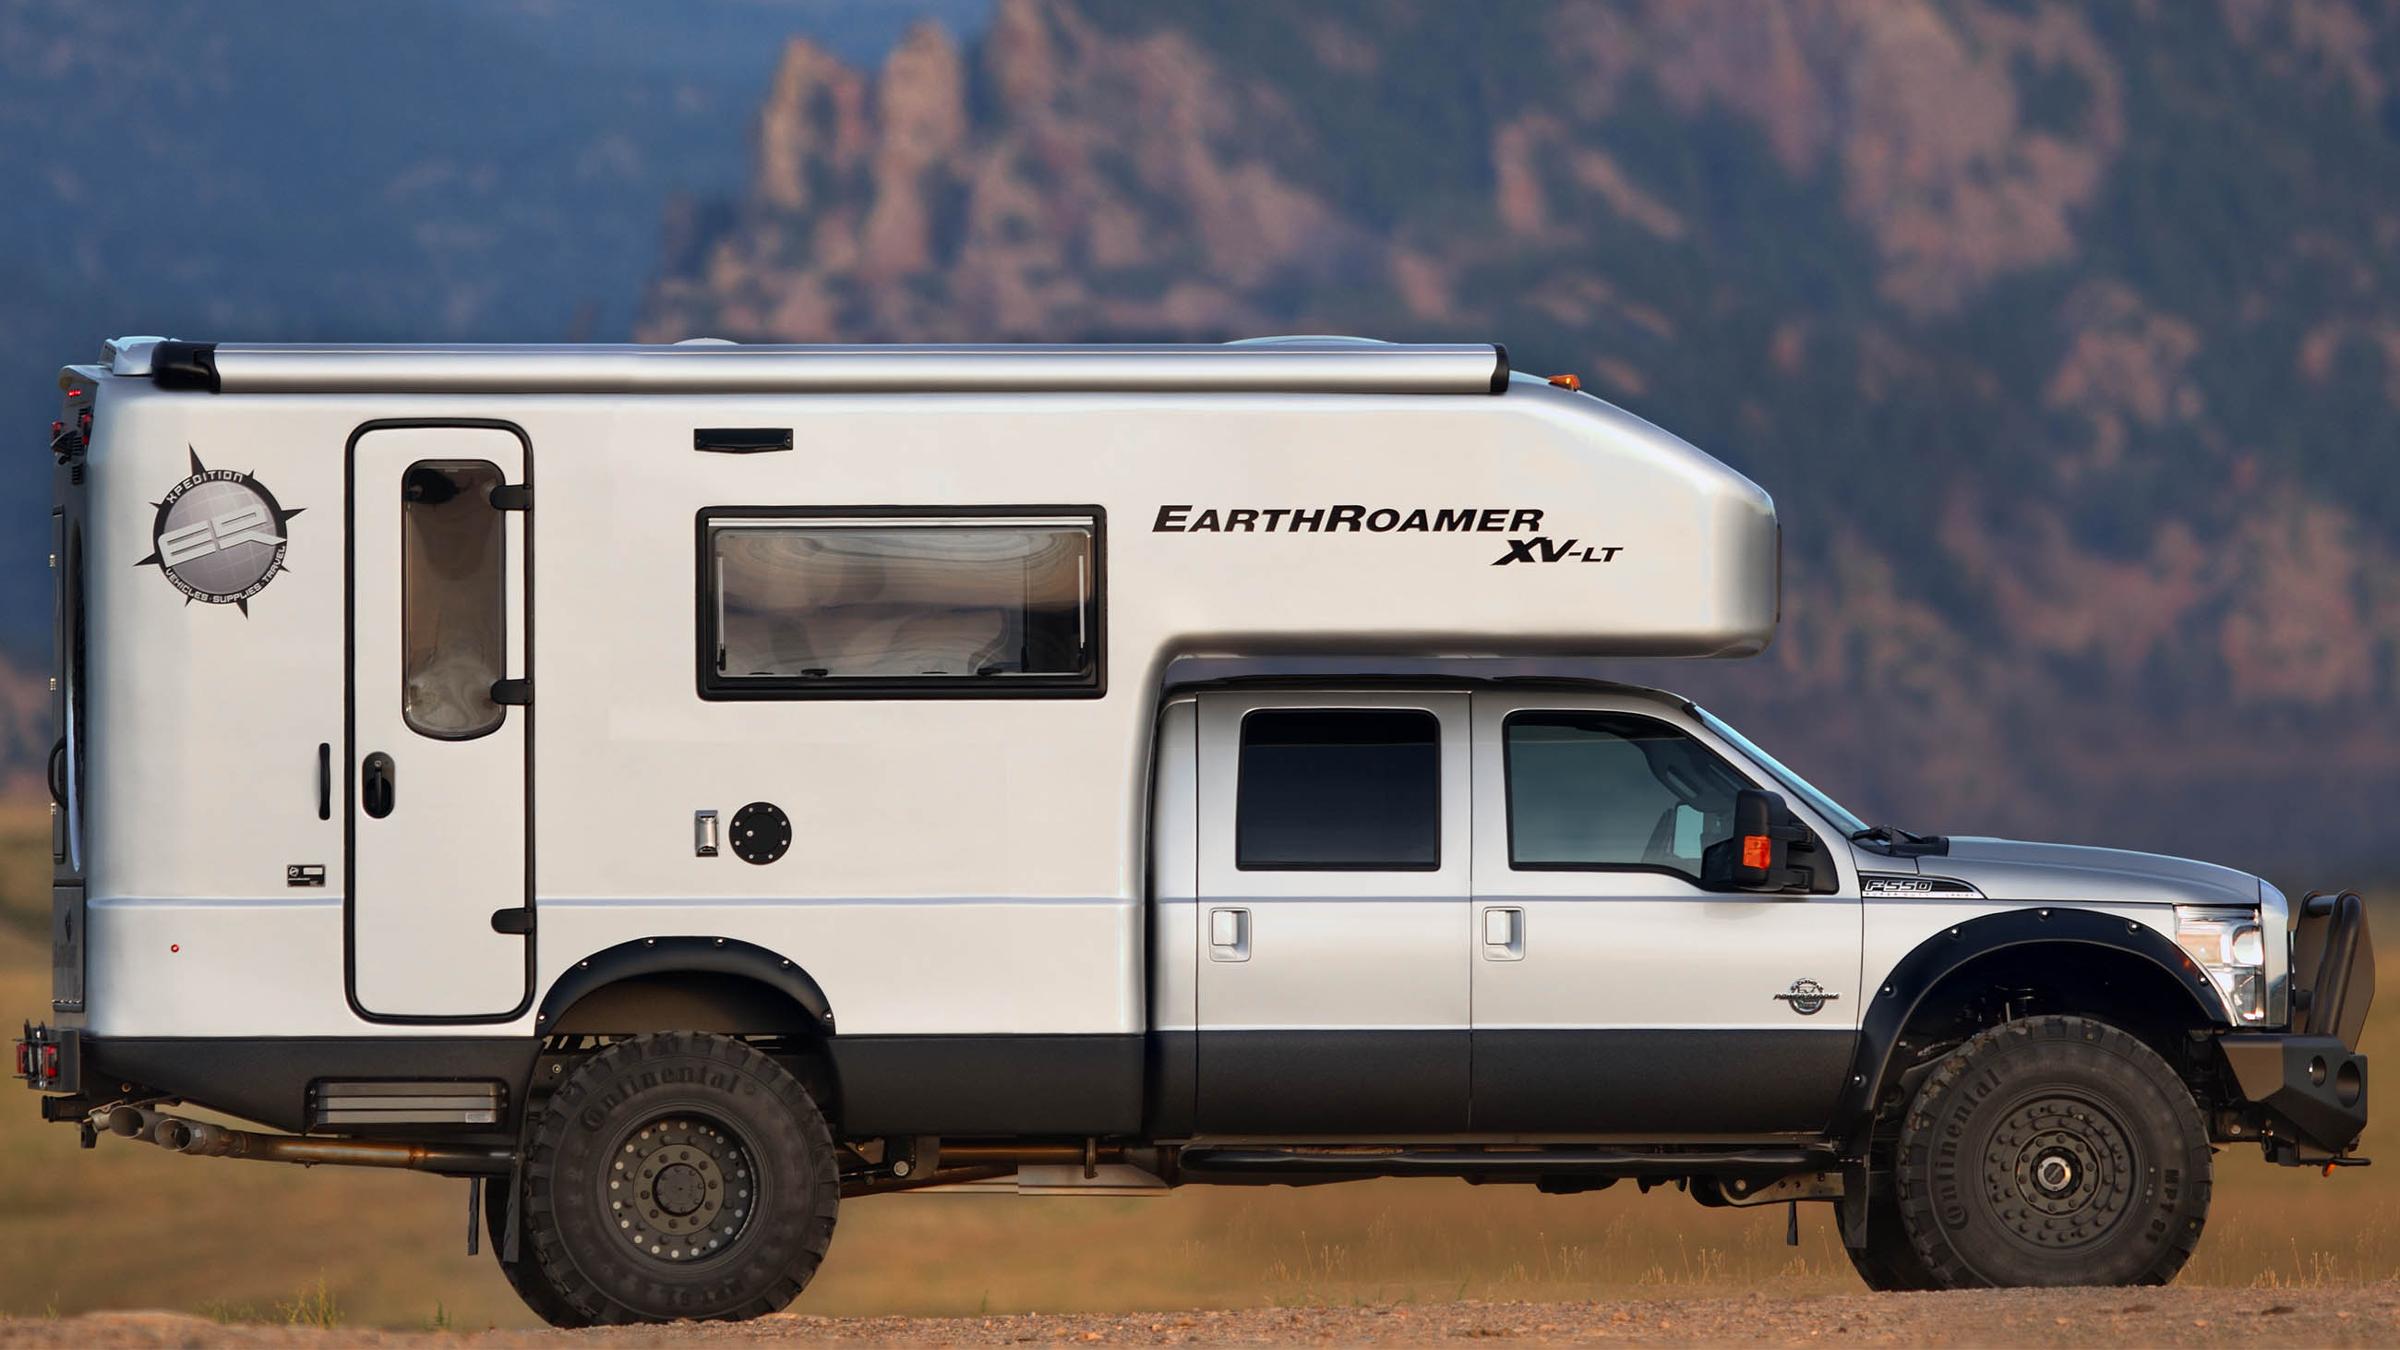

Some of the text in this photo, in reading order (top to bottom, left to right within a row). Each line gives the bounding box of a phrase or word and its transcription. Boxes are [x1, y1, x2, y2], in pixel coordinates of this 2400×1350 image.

[166, 471, 243, 503] XPEDITION
[1491, 536, 1624, 566] XV-LT
[165, 546, 286, 603] VEHICLES SUPPLIES TRAVEL
